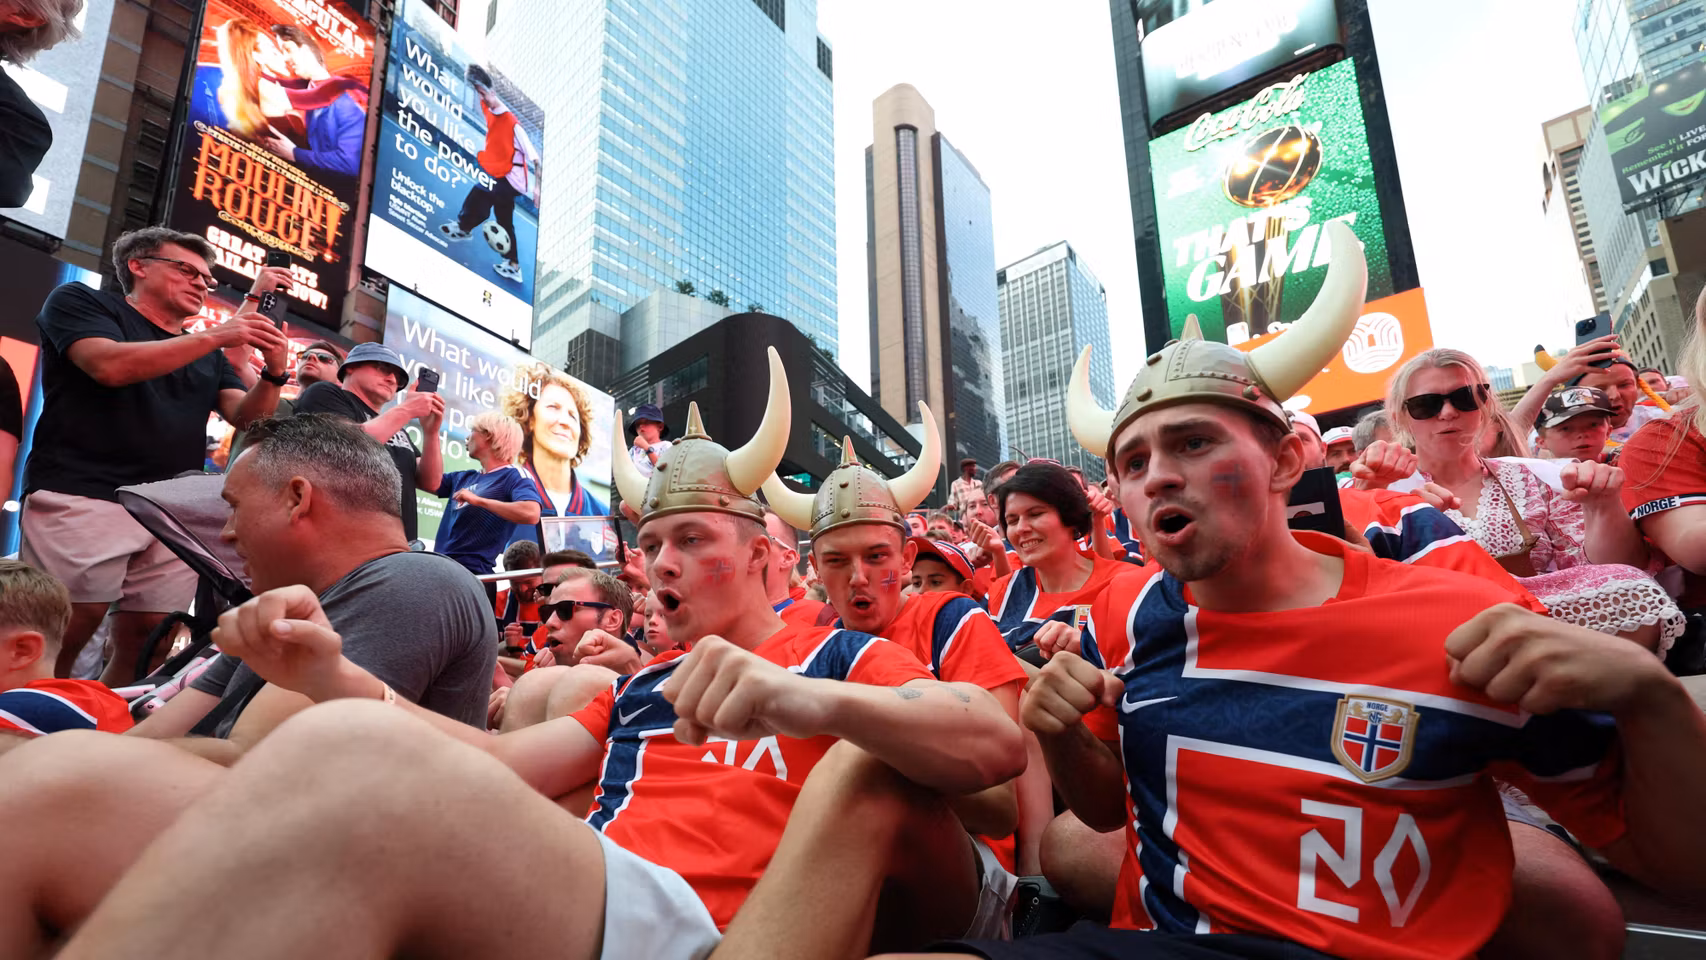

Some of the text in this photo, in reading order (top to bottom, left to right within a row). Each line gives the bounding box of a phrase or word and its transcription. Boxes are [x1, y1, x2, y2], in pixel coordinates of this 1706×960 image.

[402, 64, 463, 121] would
[405, 37, 458, 96] What
[398, 86, 476, 154] you like
[1679, 124, 1706, 140] LIVE
[395, 133, 462, 188] to do?
[398, 110, 497, 191] the power
[1622, 148, 1674, 173] Remember
[390, 178, 435, 214] blacktop.
[392, 167, 446, 208] Unlock the
[1173, 195, 1312, 267] THAT'S
[402, 315, 542, 400] What would
[455, 372, 495, 408] like
[1636, 498, 1677, 518] NORGE
[1366, 702, 1388, 712] NORGE
[1297, 798, 1432, 928] 20
